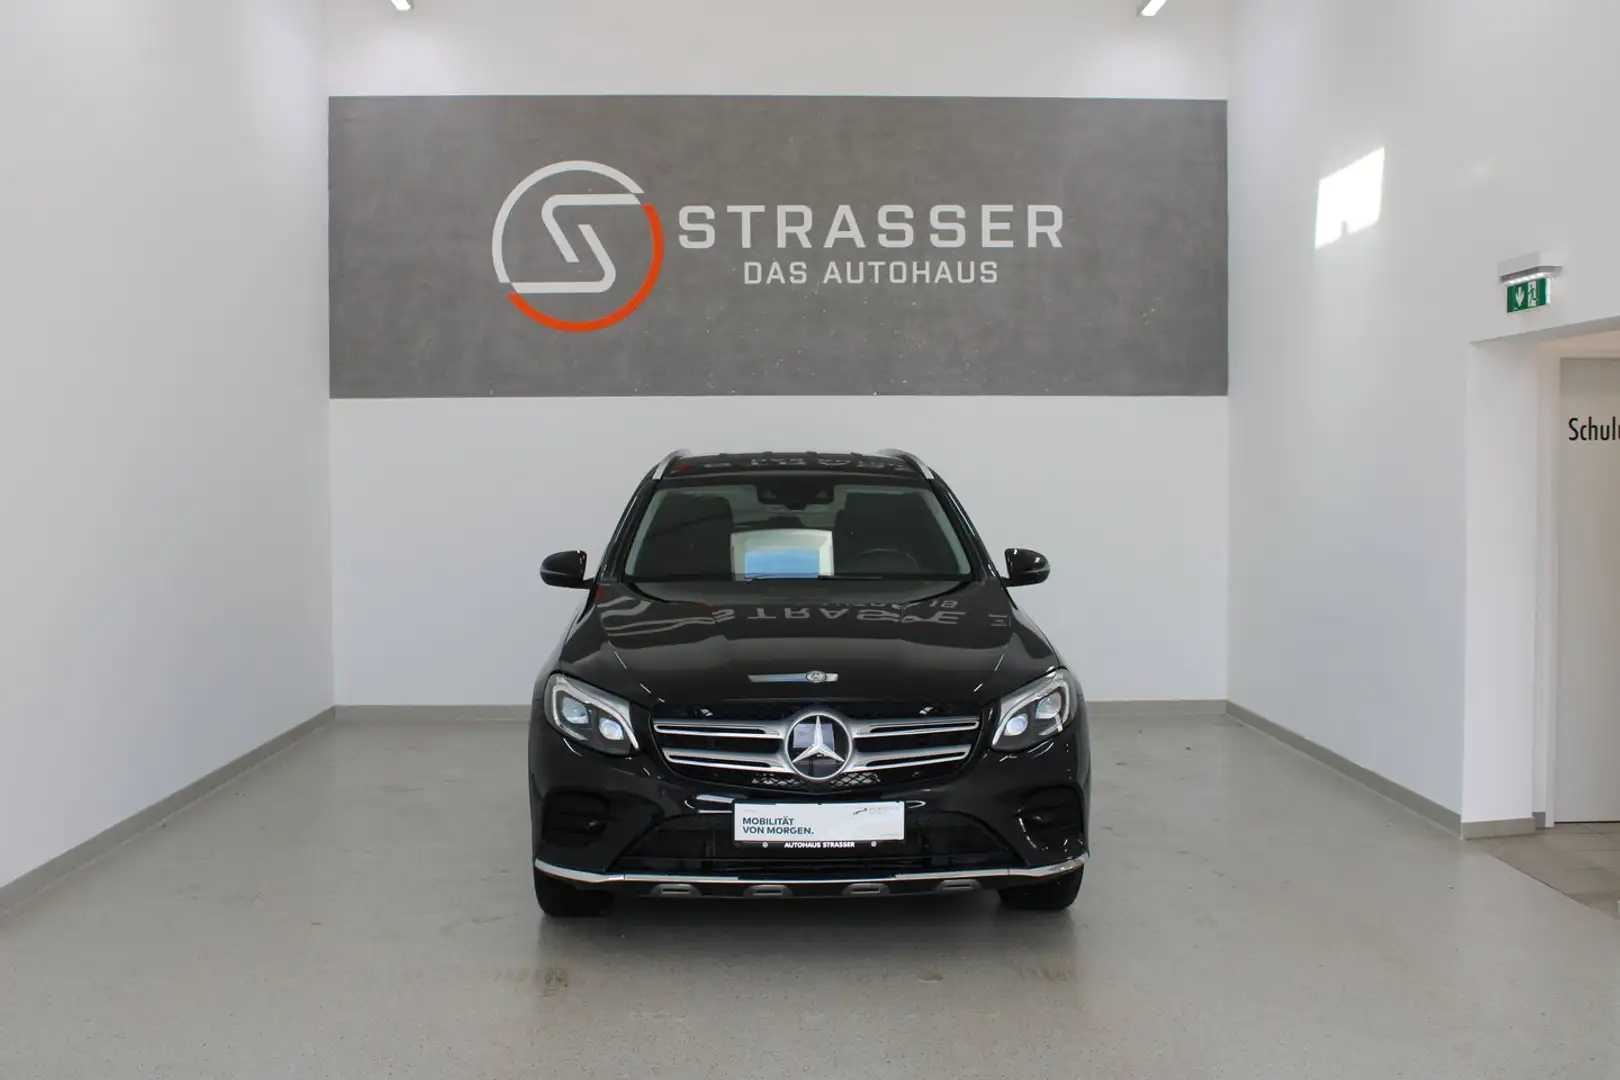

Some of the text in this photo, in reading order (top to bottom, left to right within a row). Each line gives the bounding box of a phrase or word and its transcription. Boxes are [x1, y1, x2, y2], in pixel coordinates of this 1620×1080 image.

[678, 204, 1064, 249] STRASSER
[743, 260, 999, 285] DAS AUTOHAUS
[1568, 416, 1620, 441] Schul
[742, 816, 795, 826] MOBILITÄT
[742, 826, 814, 835] VON MORGEN.
[784, 841, 855, 849] AUTOHAUS STRASSER
